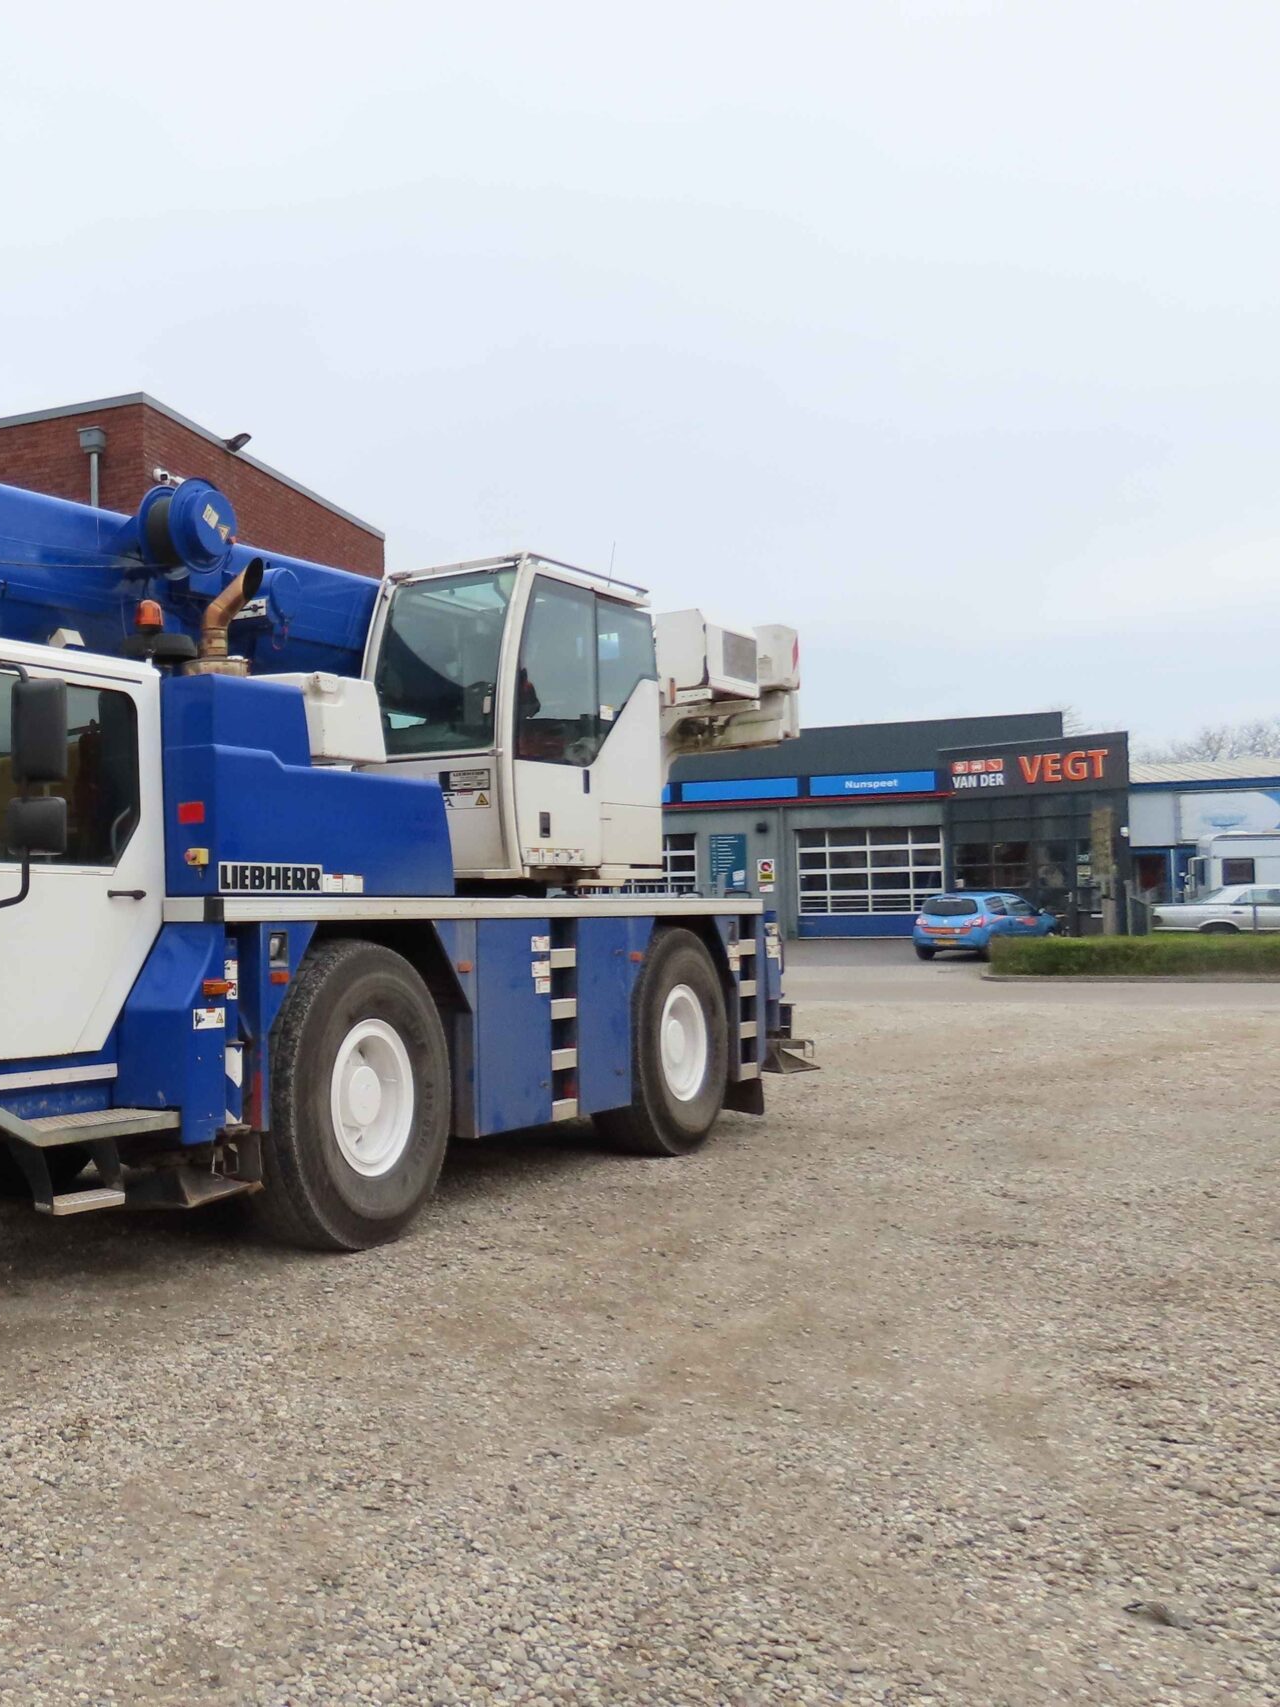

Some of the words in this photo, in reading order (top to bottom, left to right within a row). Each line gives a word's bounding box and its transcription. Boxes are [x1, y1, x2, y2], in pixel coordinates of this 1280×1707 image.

[952, 776, 977, 789] VAN
[980, 773, 1005, 787] DER
[1018, 749, 1108, 785] VEGT
[844, 779, 898, 789] Nunspeet
[220, 865, 321, 891] LIEBHERR
